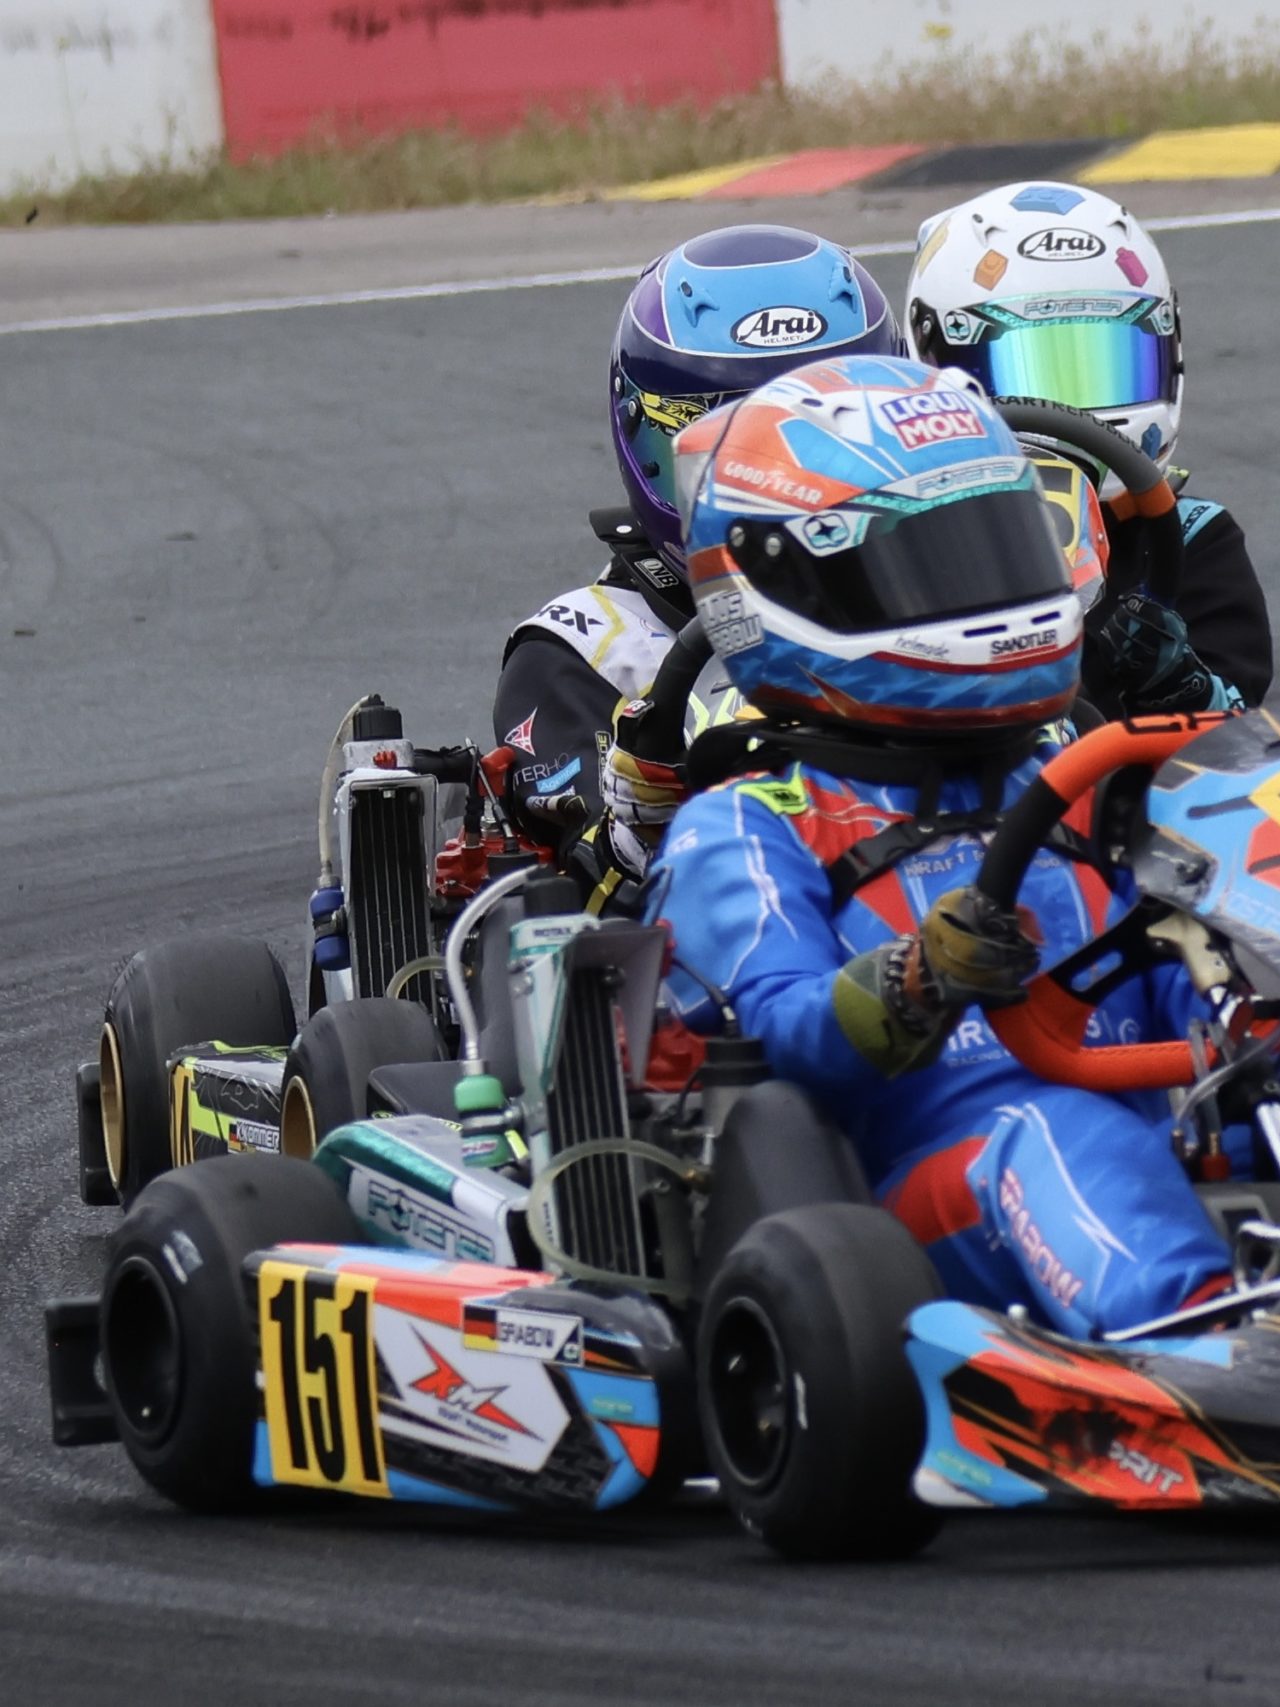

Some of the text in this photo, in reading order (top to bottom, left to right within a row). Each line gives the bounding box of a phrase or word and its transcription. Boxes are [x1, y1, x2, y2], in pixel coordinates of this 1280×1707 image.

[1025, 231, 1096, 255] Arai
[738, 311, 819, 342] Arai
[883, 388, 969, 424] LIQUI
[901, 412, 980, 446] MOLY
[268, 1270, 382, 1483] 151
